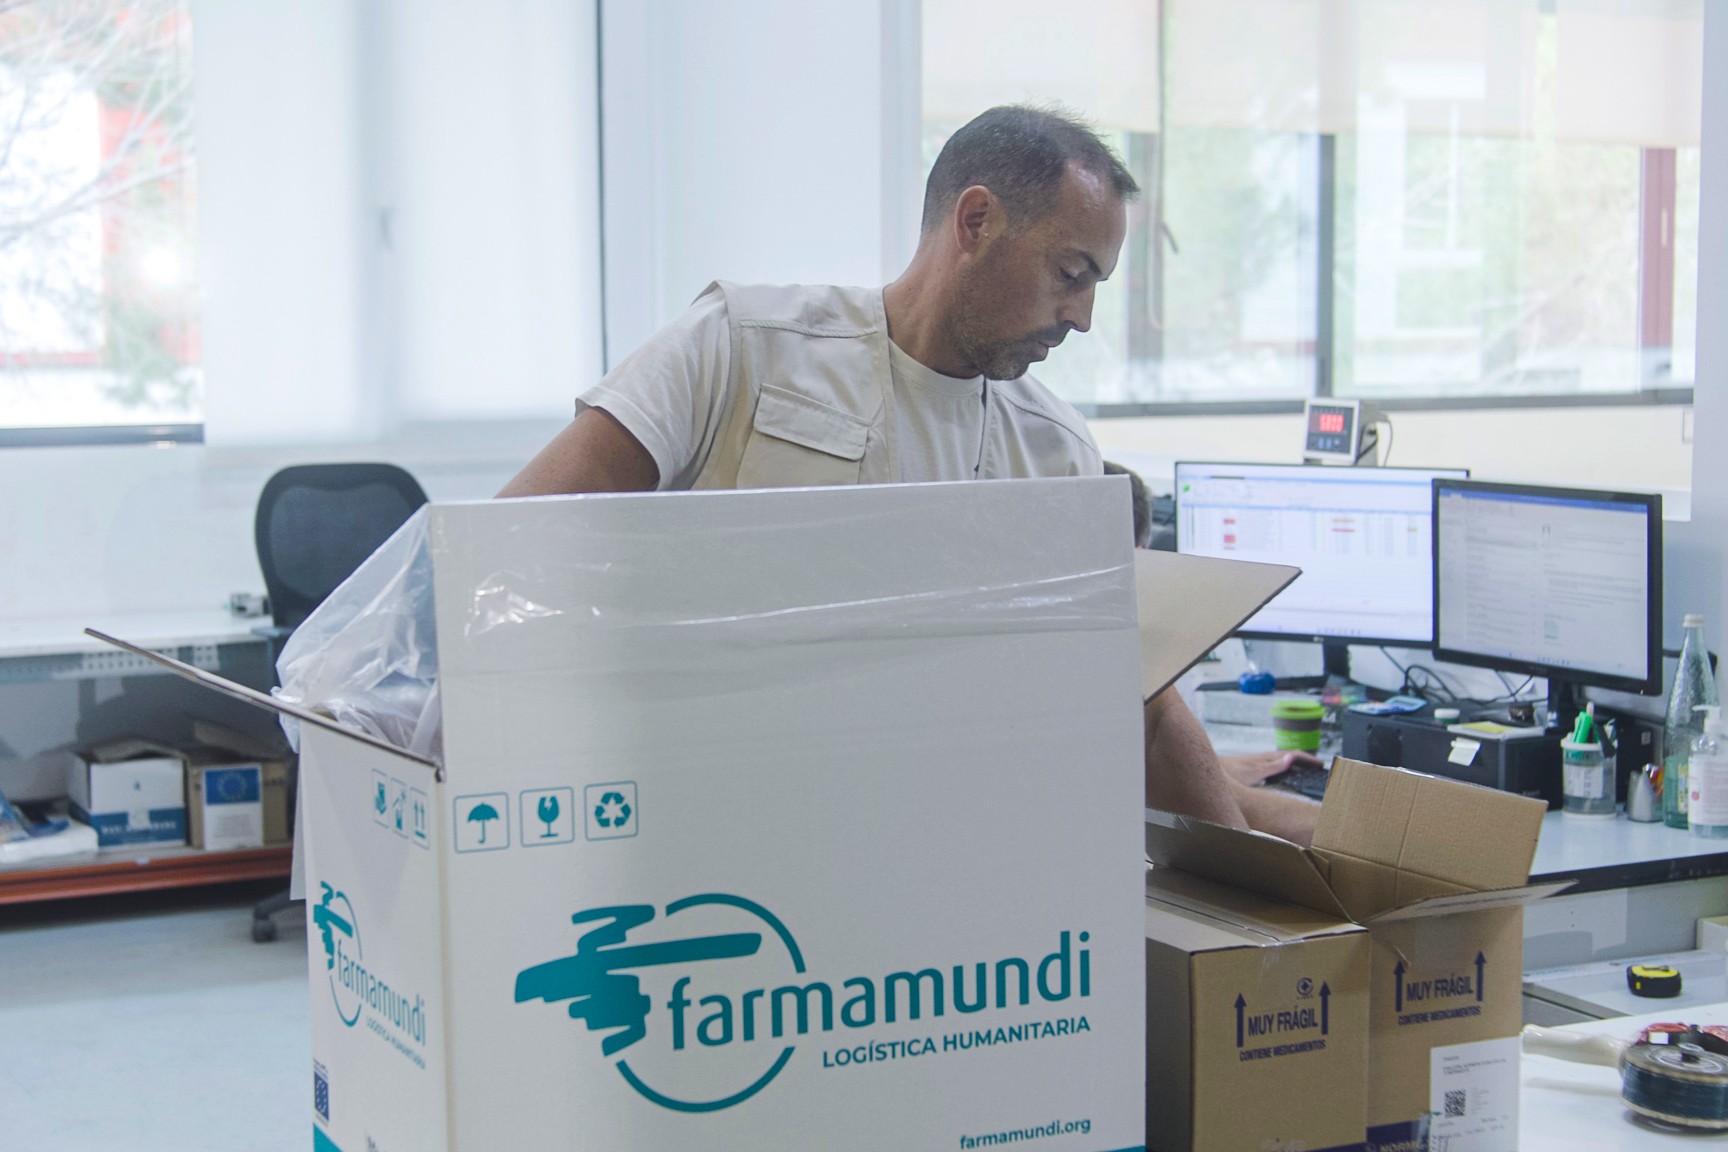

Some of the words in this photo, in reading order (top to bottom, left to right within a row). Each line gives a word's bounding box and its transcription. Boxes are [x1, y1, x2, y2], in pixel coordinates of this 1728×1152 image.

[337, 938, 426, 1046] farmamundi
[667, 931, 1091, 1051] farmamundi
[1407, 981, 1433, 1002] MUY
[1434, 973, 1473, 998] FRÁGIL
[1248, 1014, 1275, 1037] MUY
[1277, 1005, 1318, 1032] FRÁGIL
[1399, 1012, 1429, 1025] CONTIENE
[1430, 1005, 1481, 1021] MEDICAMENTOS
[823, 1037, 937, 1068] LOGÍSTICA
[943, 1015, 1091, 1051] HUMANITARIA
[1240, 1047, 1273, 1062] CONTIENE
[1273, 1039, 1327, 1057] MEDICAMENTOS
[960, 1118, 1092, 1150] farmamundi.org
